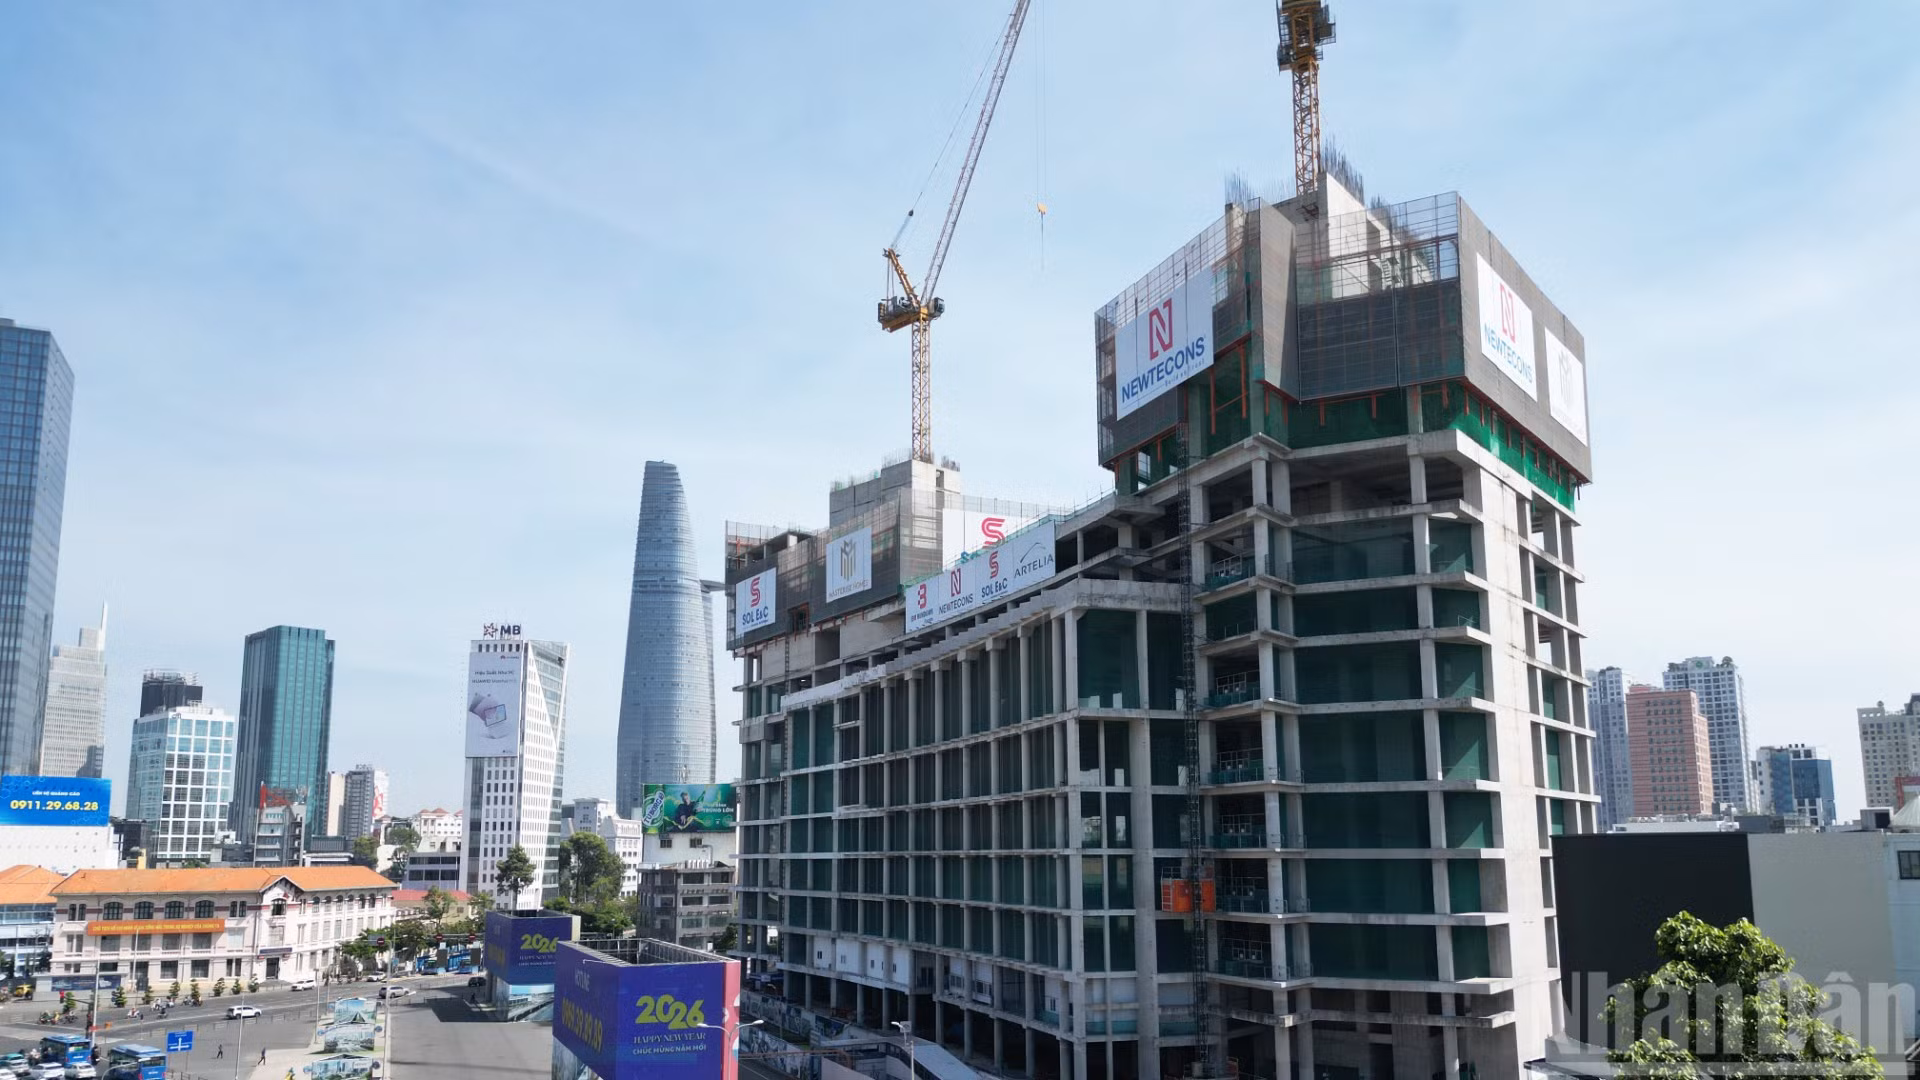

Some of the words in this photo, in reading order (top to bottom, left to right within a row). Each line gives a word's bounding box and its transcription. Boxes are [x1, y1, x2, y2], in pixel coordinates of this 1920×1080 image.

[1484, 322, 1533, 384] NEWTECONS
[1121, 336, 1206, 403] NEWTECONS
[1014, 553, 1054, 579] ARTELIA
[981, 586, 995, 598] SOL
[939, 593, 974, 615] NEWTECONS
[742, 611, 755, 626] SOL
[500, 624, 521, 636] MB
[10, 799, 98, 811] 0911.29.68.28
[643, 792, 665, 824] TUBORG
[521, 933, 559, 953] 2026
[635, 994, 704, 1030] 2026
[634, 1035, 662, 1044] HAPPY
[663, 1034, 683, 1042] NEW
[684, 1032, 706, 1041] YEAR
